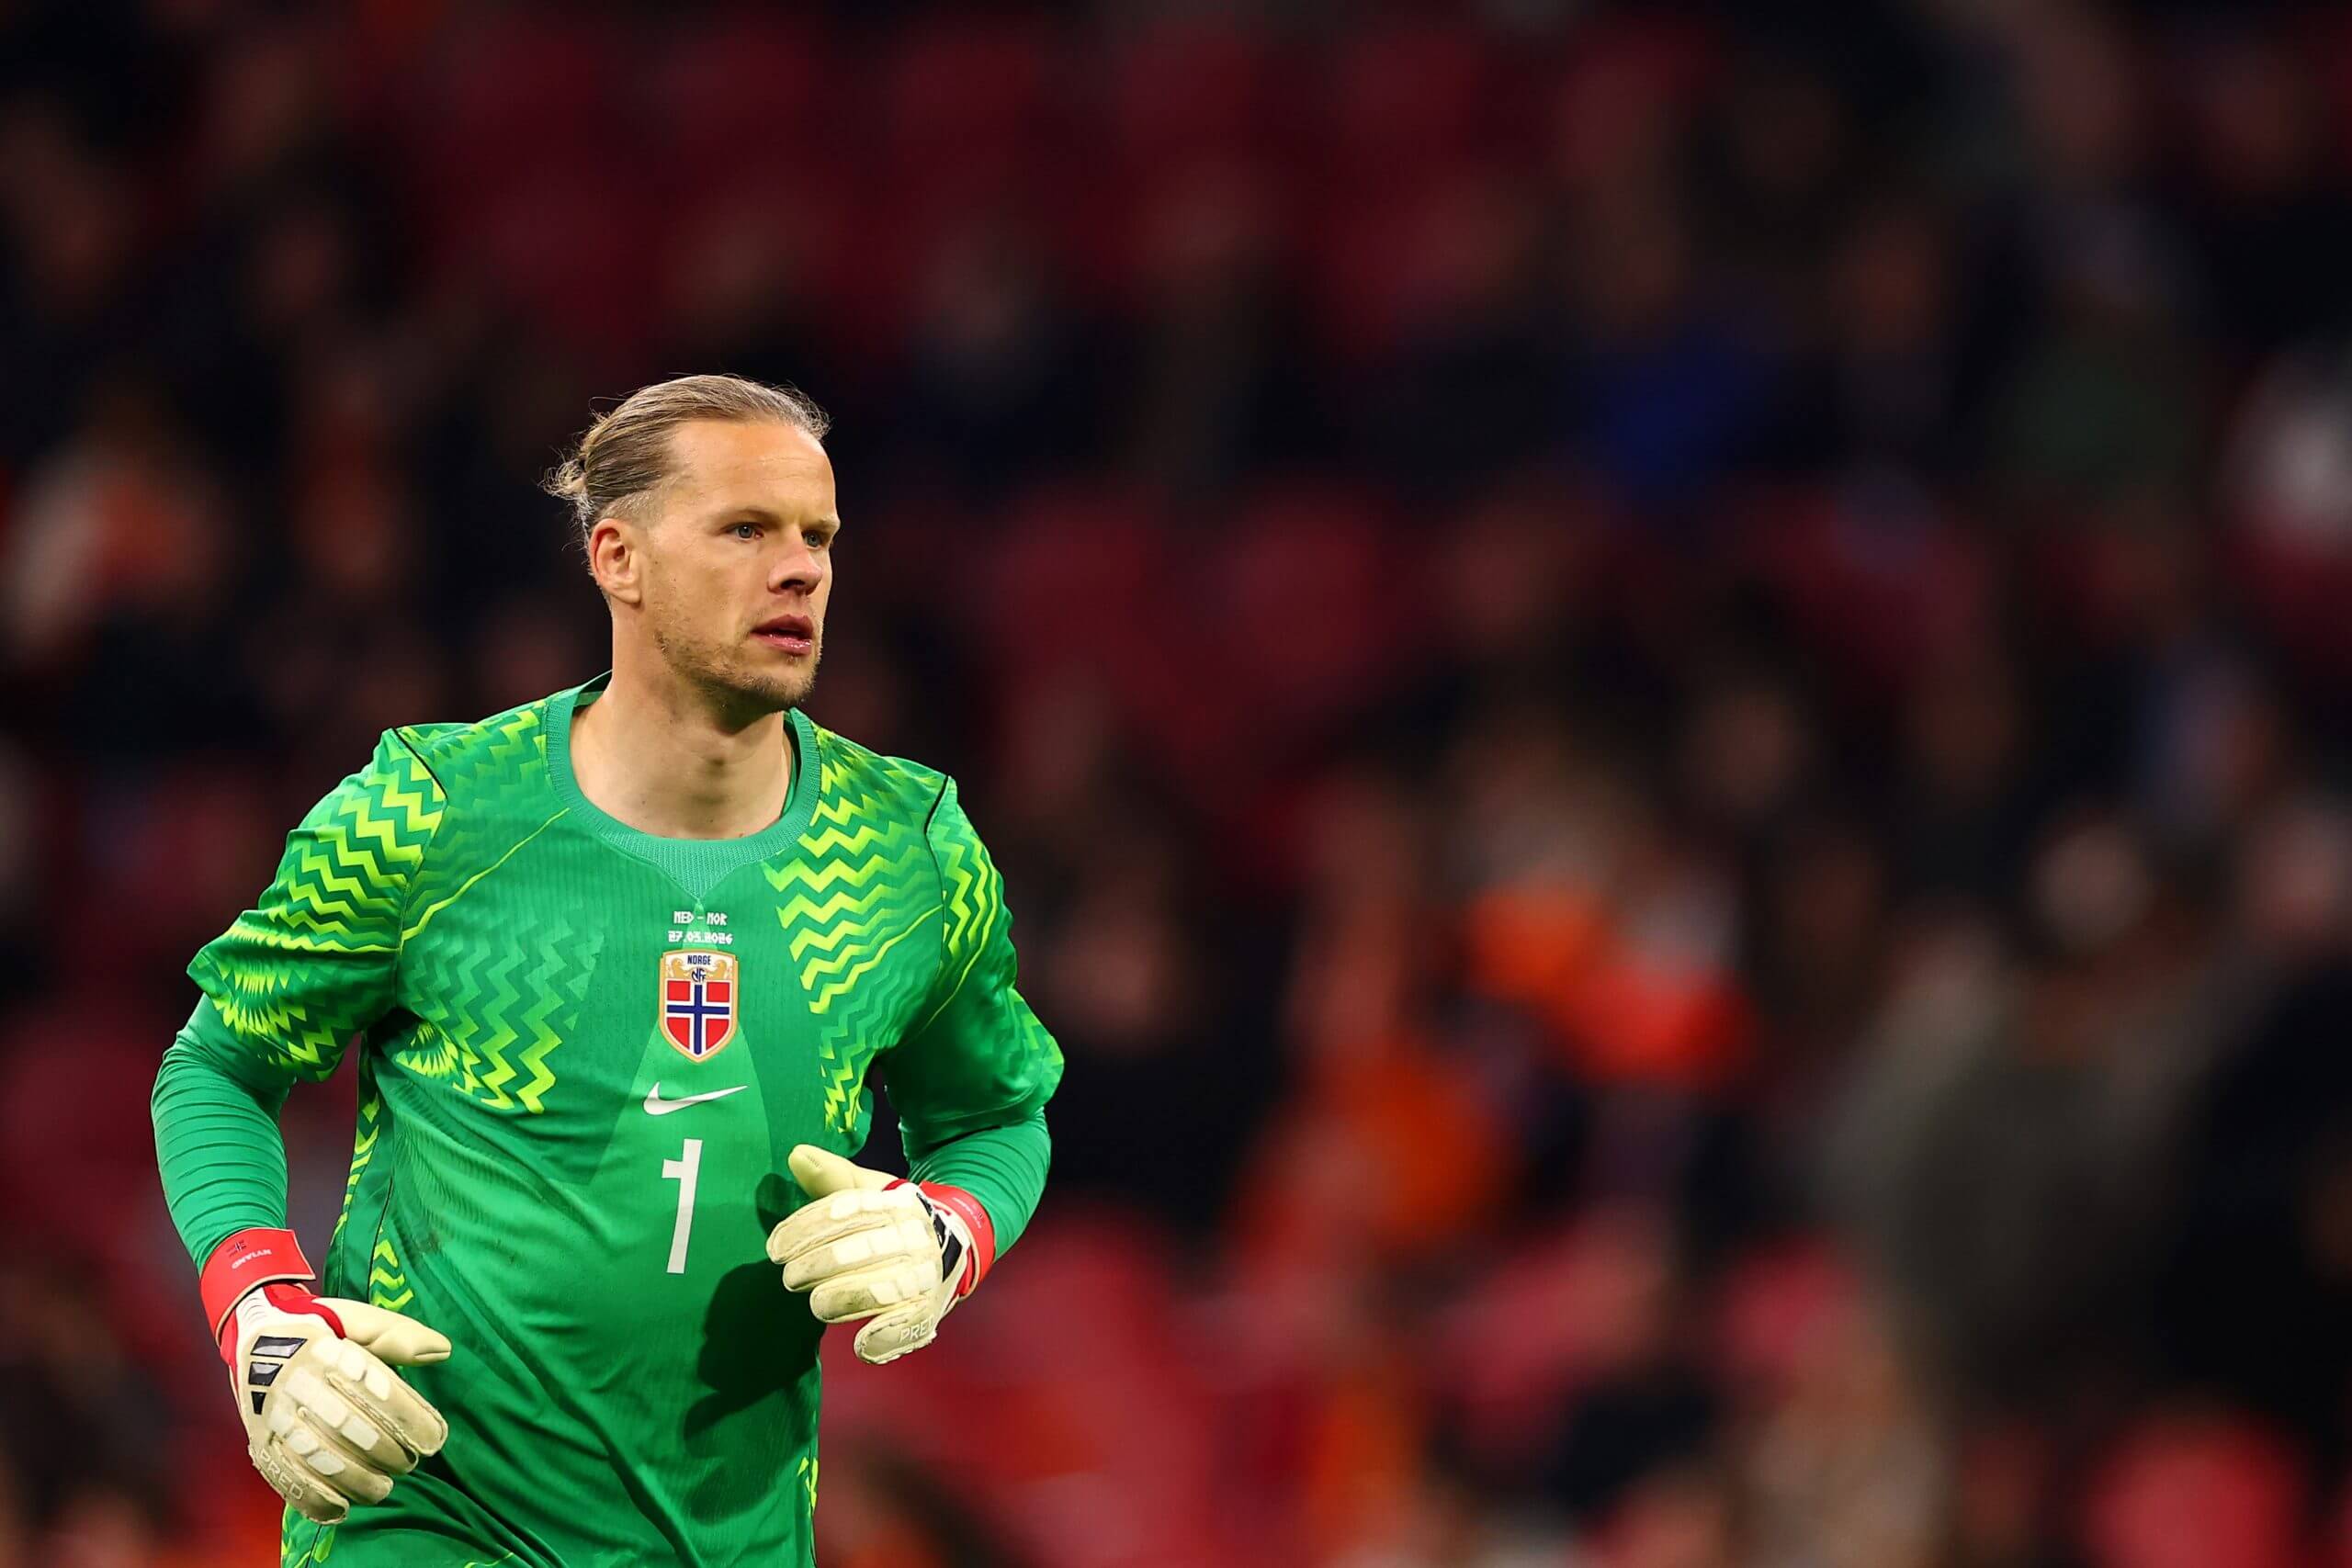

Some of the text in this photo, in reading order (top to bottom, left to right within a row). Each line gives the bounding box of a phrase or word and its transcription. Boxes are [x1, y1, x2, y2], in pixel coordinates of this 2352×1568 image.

[673, 910, 695, 924] NED
[706, 912, 728, 926] NOR
[687, 954, 711, 965] NORGE
[662, 1138, 703, 1274] 1
[259, 1447, 304, 1500] PRED
